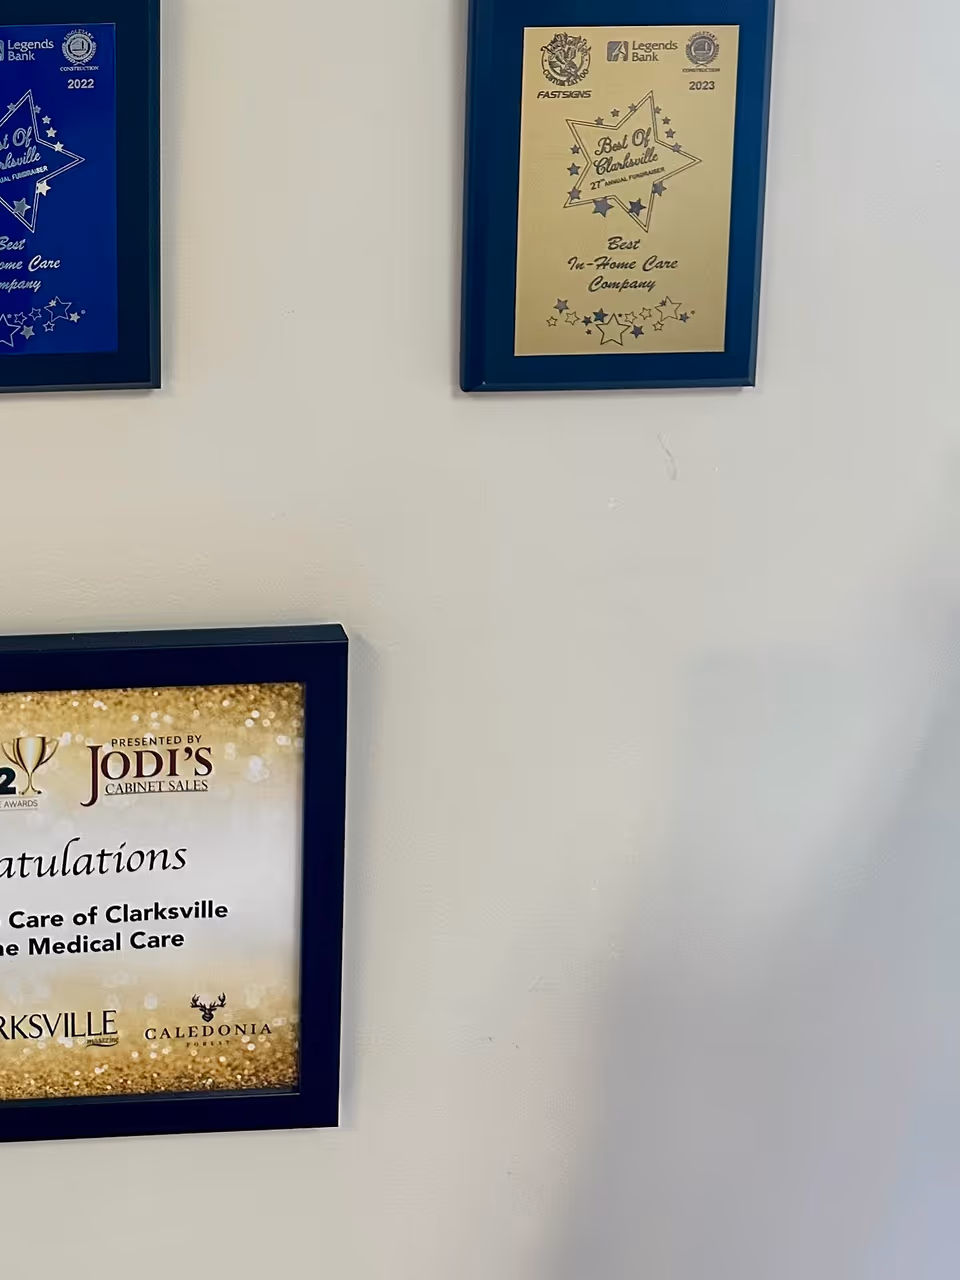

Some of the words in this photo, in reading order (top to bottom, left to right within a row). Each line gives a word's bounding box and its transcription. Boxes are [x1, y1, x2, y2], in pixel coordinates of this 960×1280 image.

[7, 39, 54, 51] Legends
[632, 40, 678, 52] Legends
[7, 50, 36, 61] Bank
[632, 51, 659, 62] Bank
[67, 78, 95, 89] 2022
[689, 81, 715, 91] 2023
[537, 90, 592, 99] FASTSIGNS
[12, 126, 33, 149] Of
[594, 135, 628, 156] Best
[632, 127, 651, 148] Of
[594, 147, 658, 175] Clarksville
[607, 236, 640, 250] Best
[28, 255, 60, 271] Care
[568, 256, 636, 270] In-Home
[642, 255, 678, 271] Care
[588, 276, 656, 292] Company
[111, 735, 182, 747] PRESENTED
[187, 735, 202, 743] BY
[80, 745, 213, 807] JODI'S
[105, 780, 165, 794] CABINET
[168, 780, 208, 791] SALES
[4, 800, 38, 808] AWARDS
[8, 910, 64, 929] Care
[72, 906, 98, 927] of
[105, 900, 229, 925] Clarksville
[28, 932, 121, 955] Medical
[130, 931, 185, 950] Care
[145, 1023, 272, 1040] CALEDONIA
